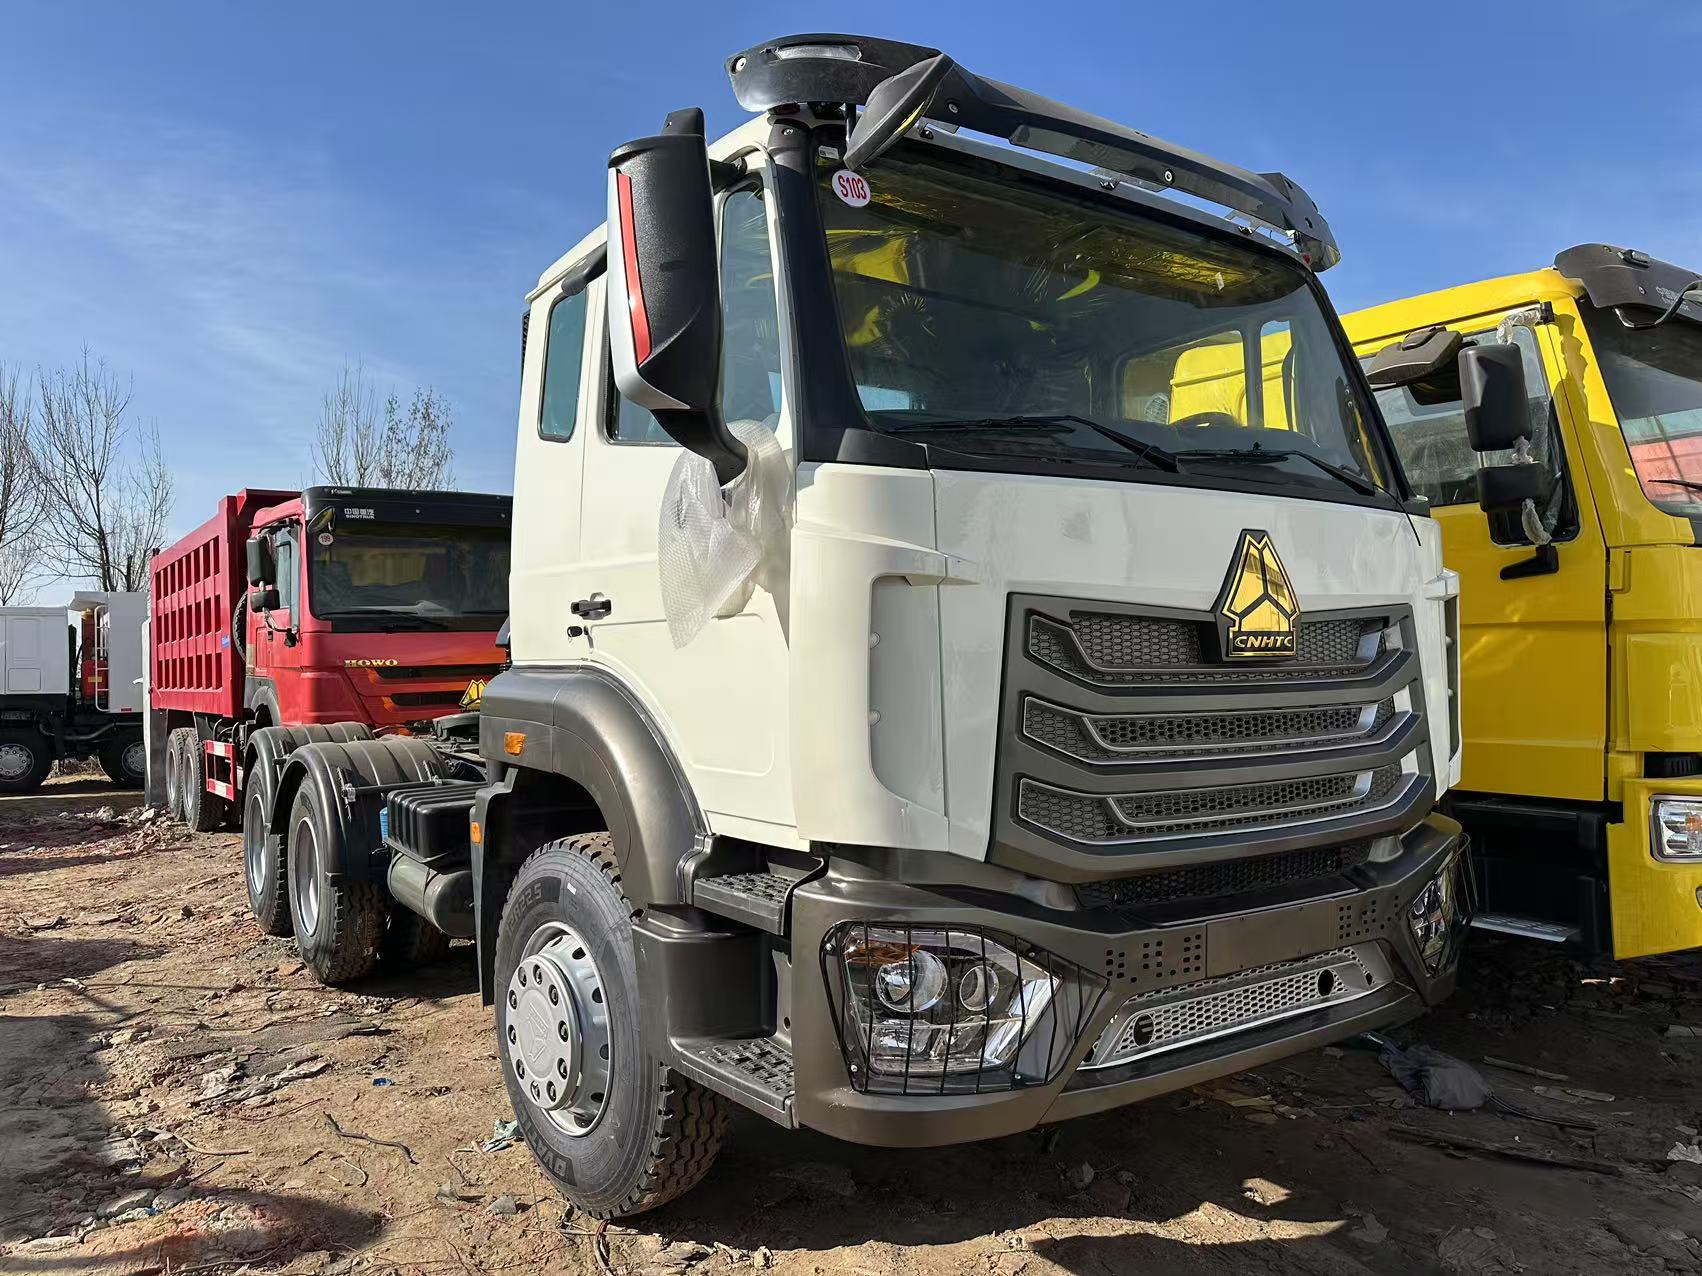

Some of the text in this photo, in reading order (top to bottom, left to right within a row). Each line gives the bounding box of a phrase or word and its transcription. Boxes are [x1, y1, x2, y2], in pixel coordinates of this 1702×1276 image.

[837, 174, 867, 200] S103
[1234, 636, 1293, 648] CNHTC
[343, 659, 398, 668] HOWO
